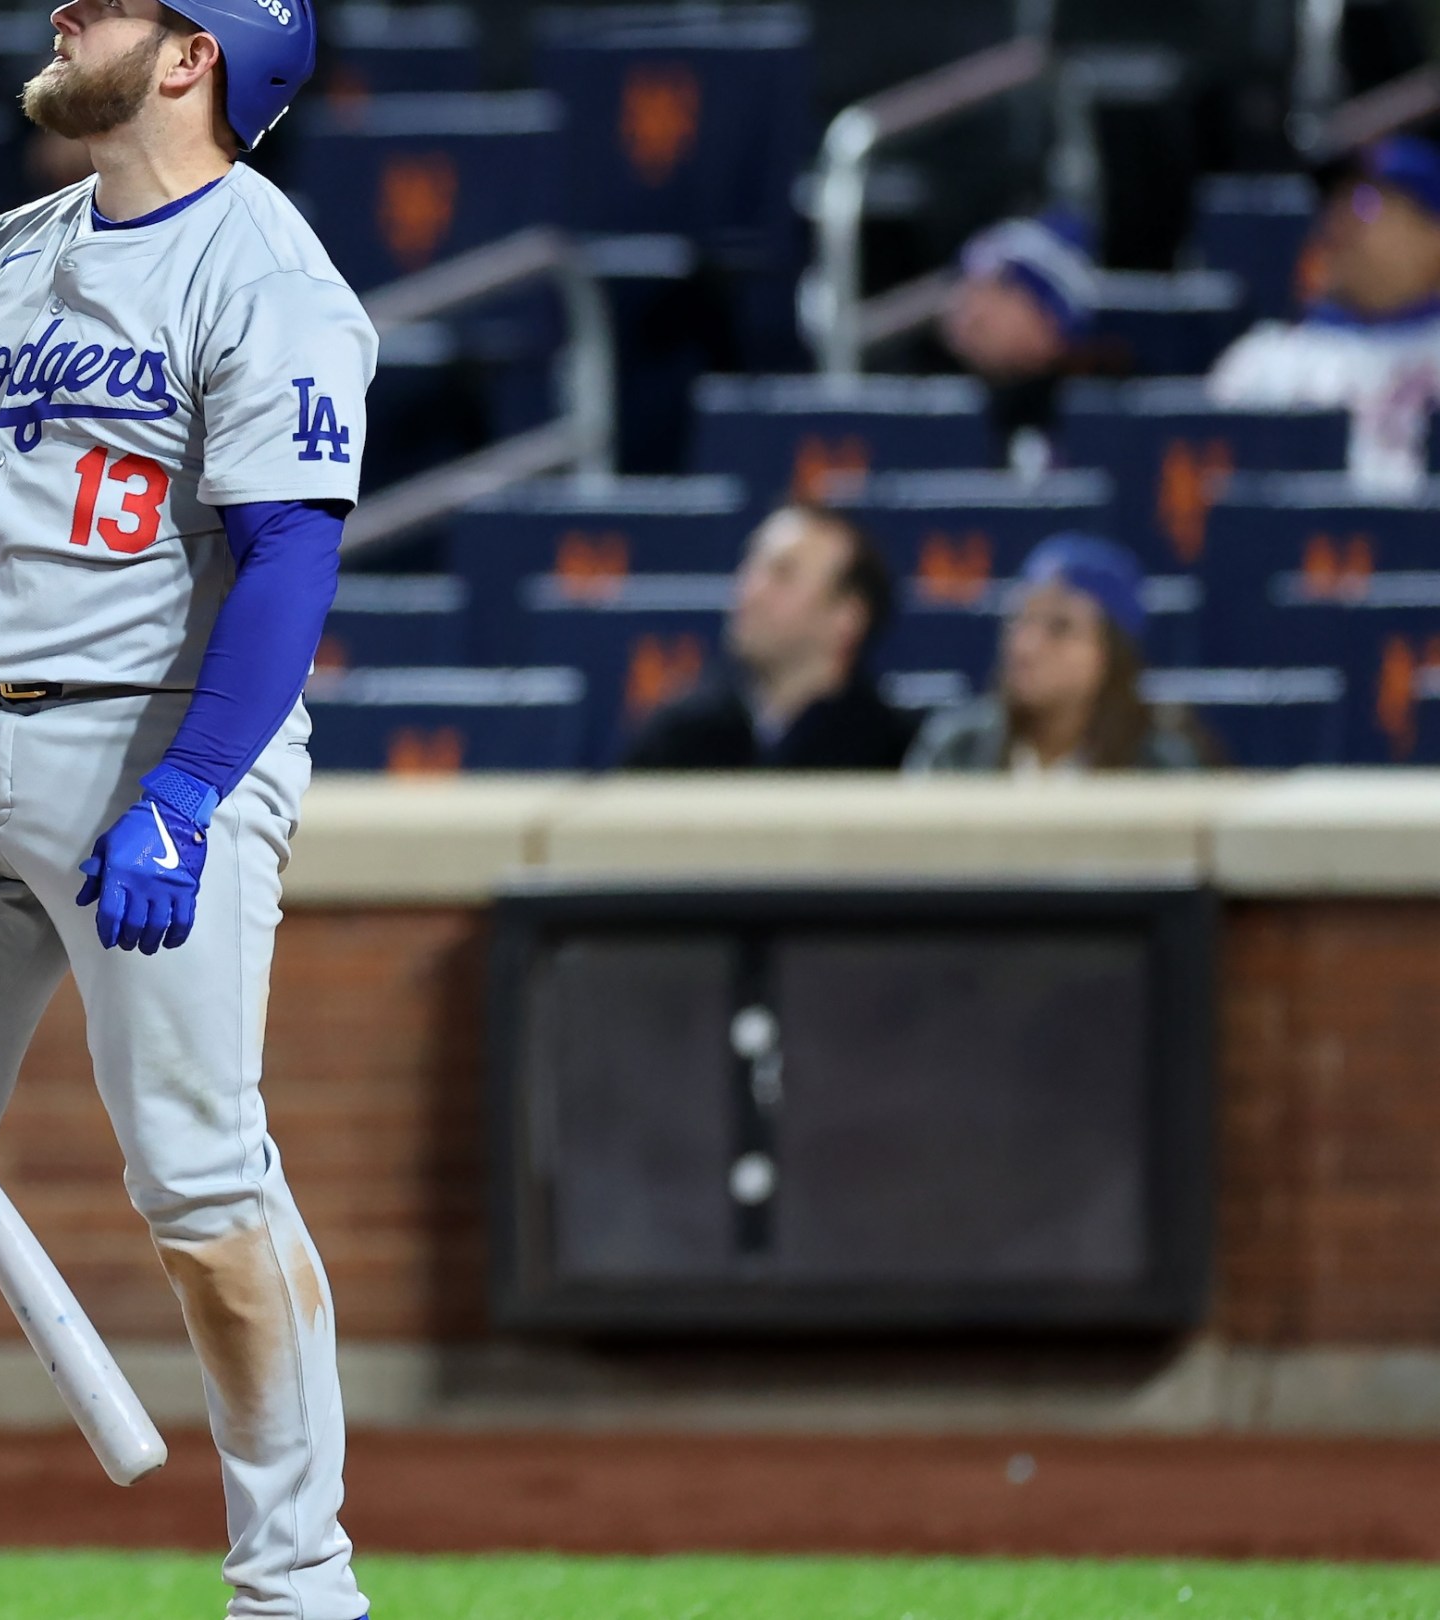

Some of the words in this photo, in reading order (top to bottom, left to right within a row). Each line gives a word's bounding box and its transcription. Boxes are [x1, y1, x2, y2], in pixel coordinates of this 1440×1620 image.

[254, 0, 292, 26] USS
[292, 377, 350, 463] LA
[69, 446, 170, 554] 13
